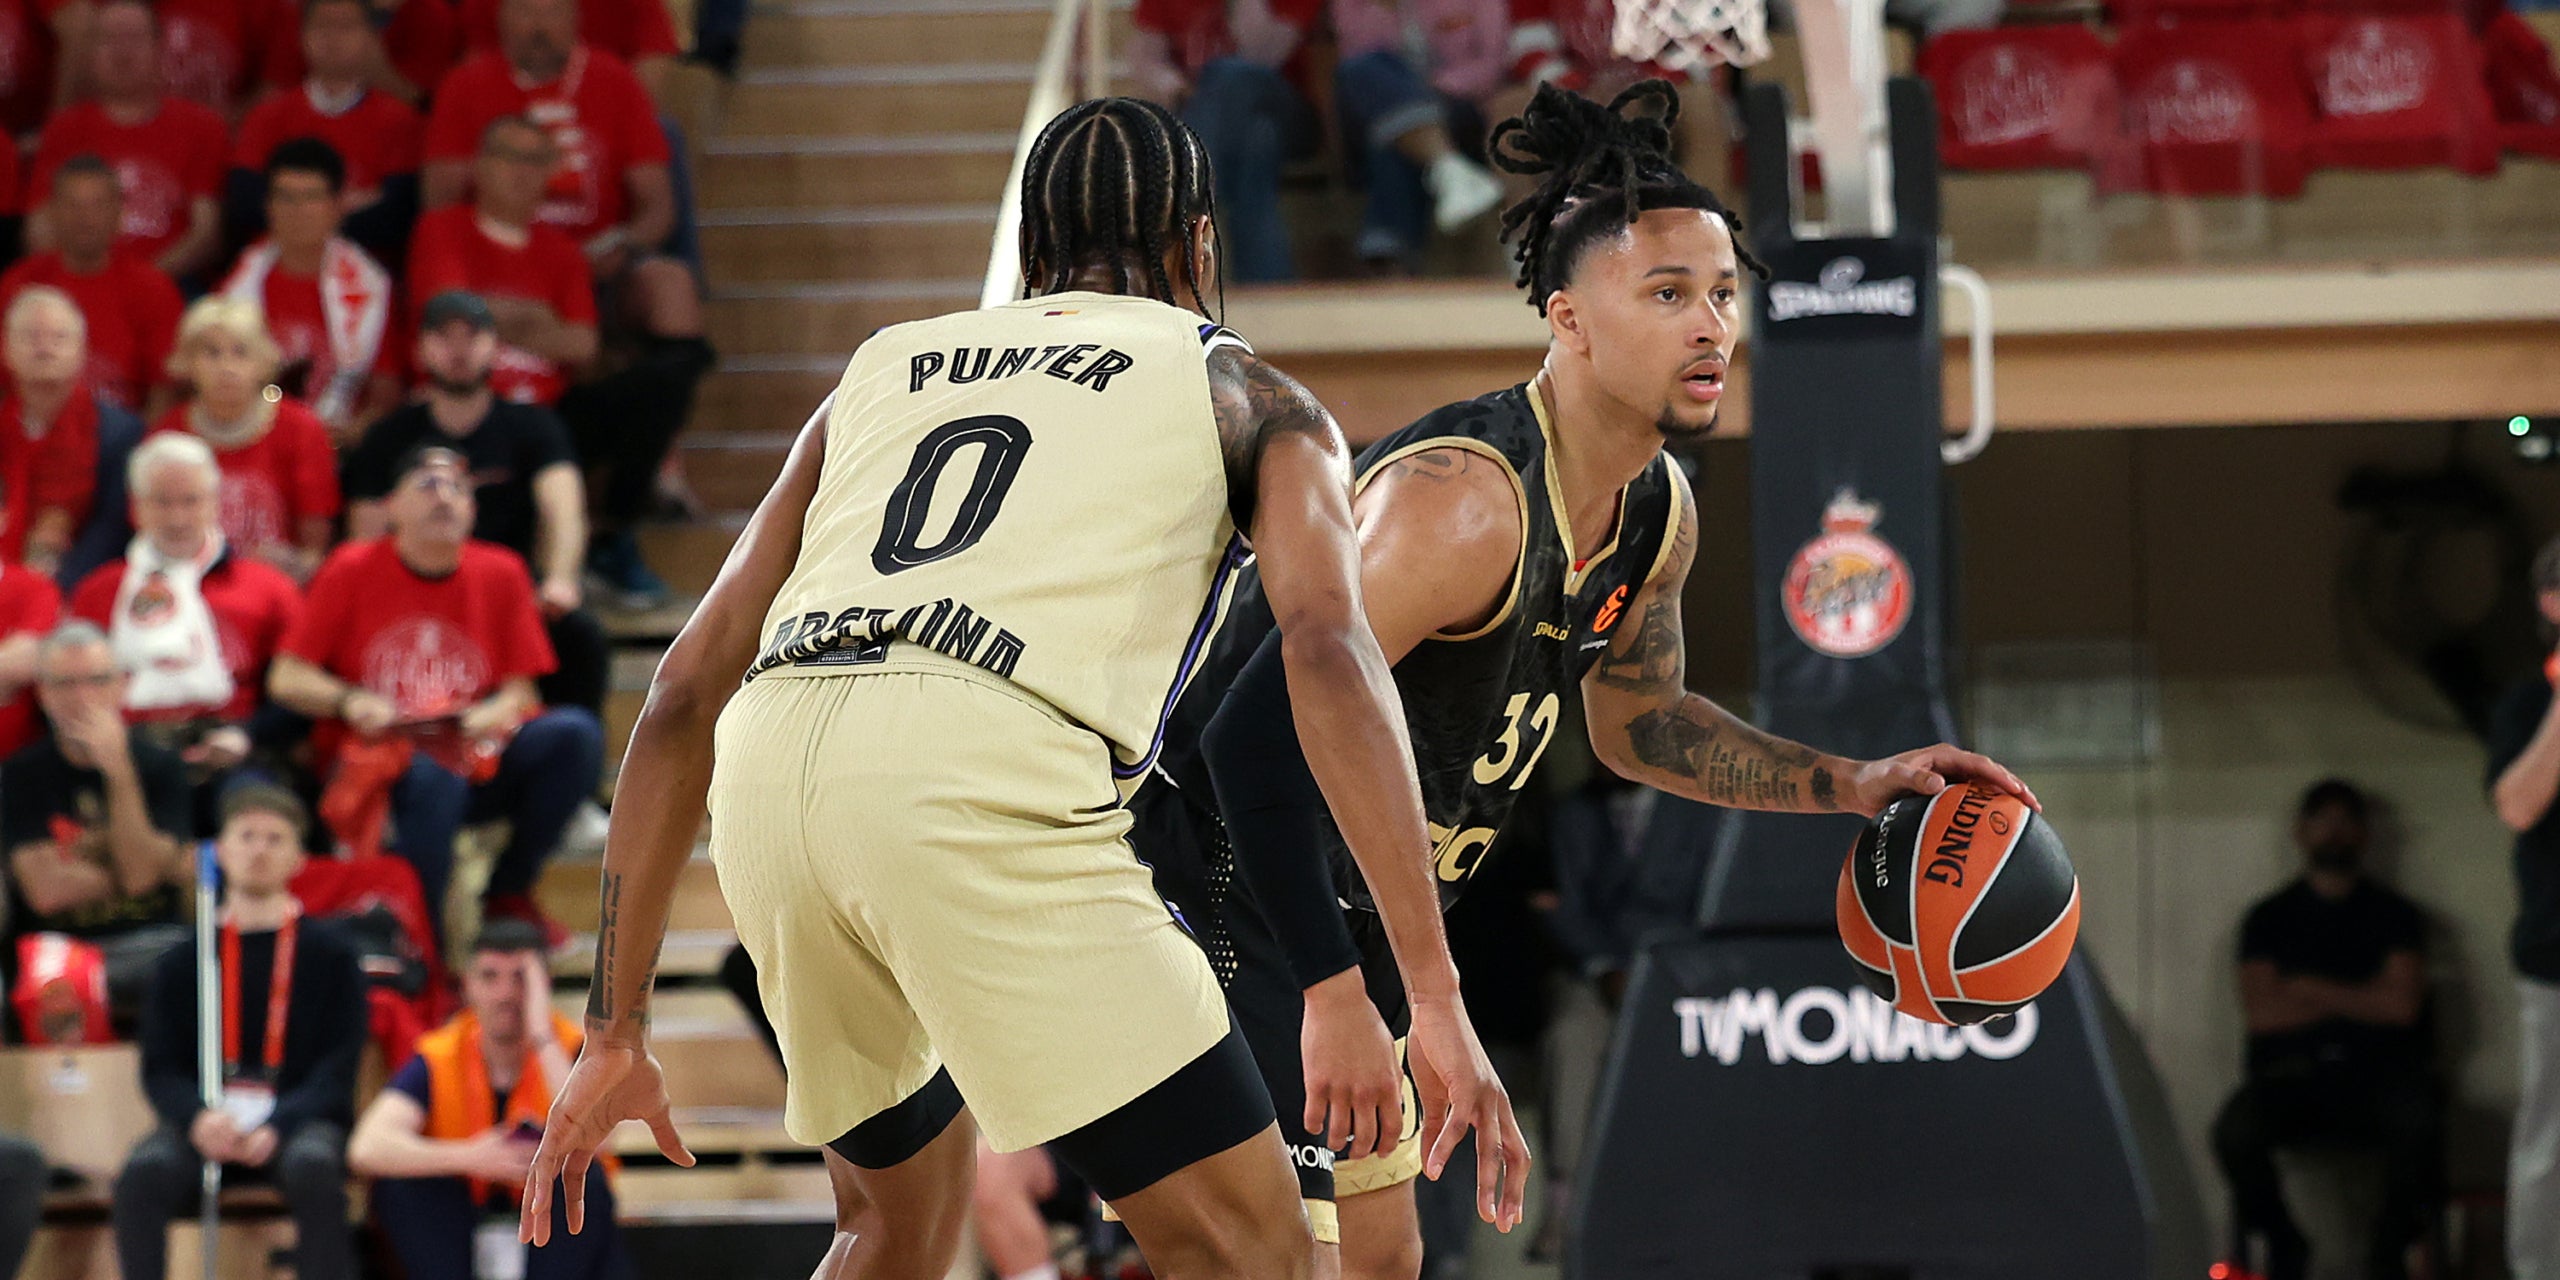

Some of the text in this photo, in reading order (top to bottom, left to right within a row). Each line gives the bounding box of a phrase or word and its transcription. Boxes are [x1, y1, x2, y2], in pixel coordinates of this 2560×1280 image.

[909, 344, 1134, 394] PUNTER
[870, 414, 1033, 576] 0
[1473, 692, 1559, 791] 32
